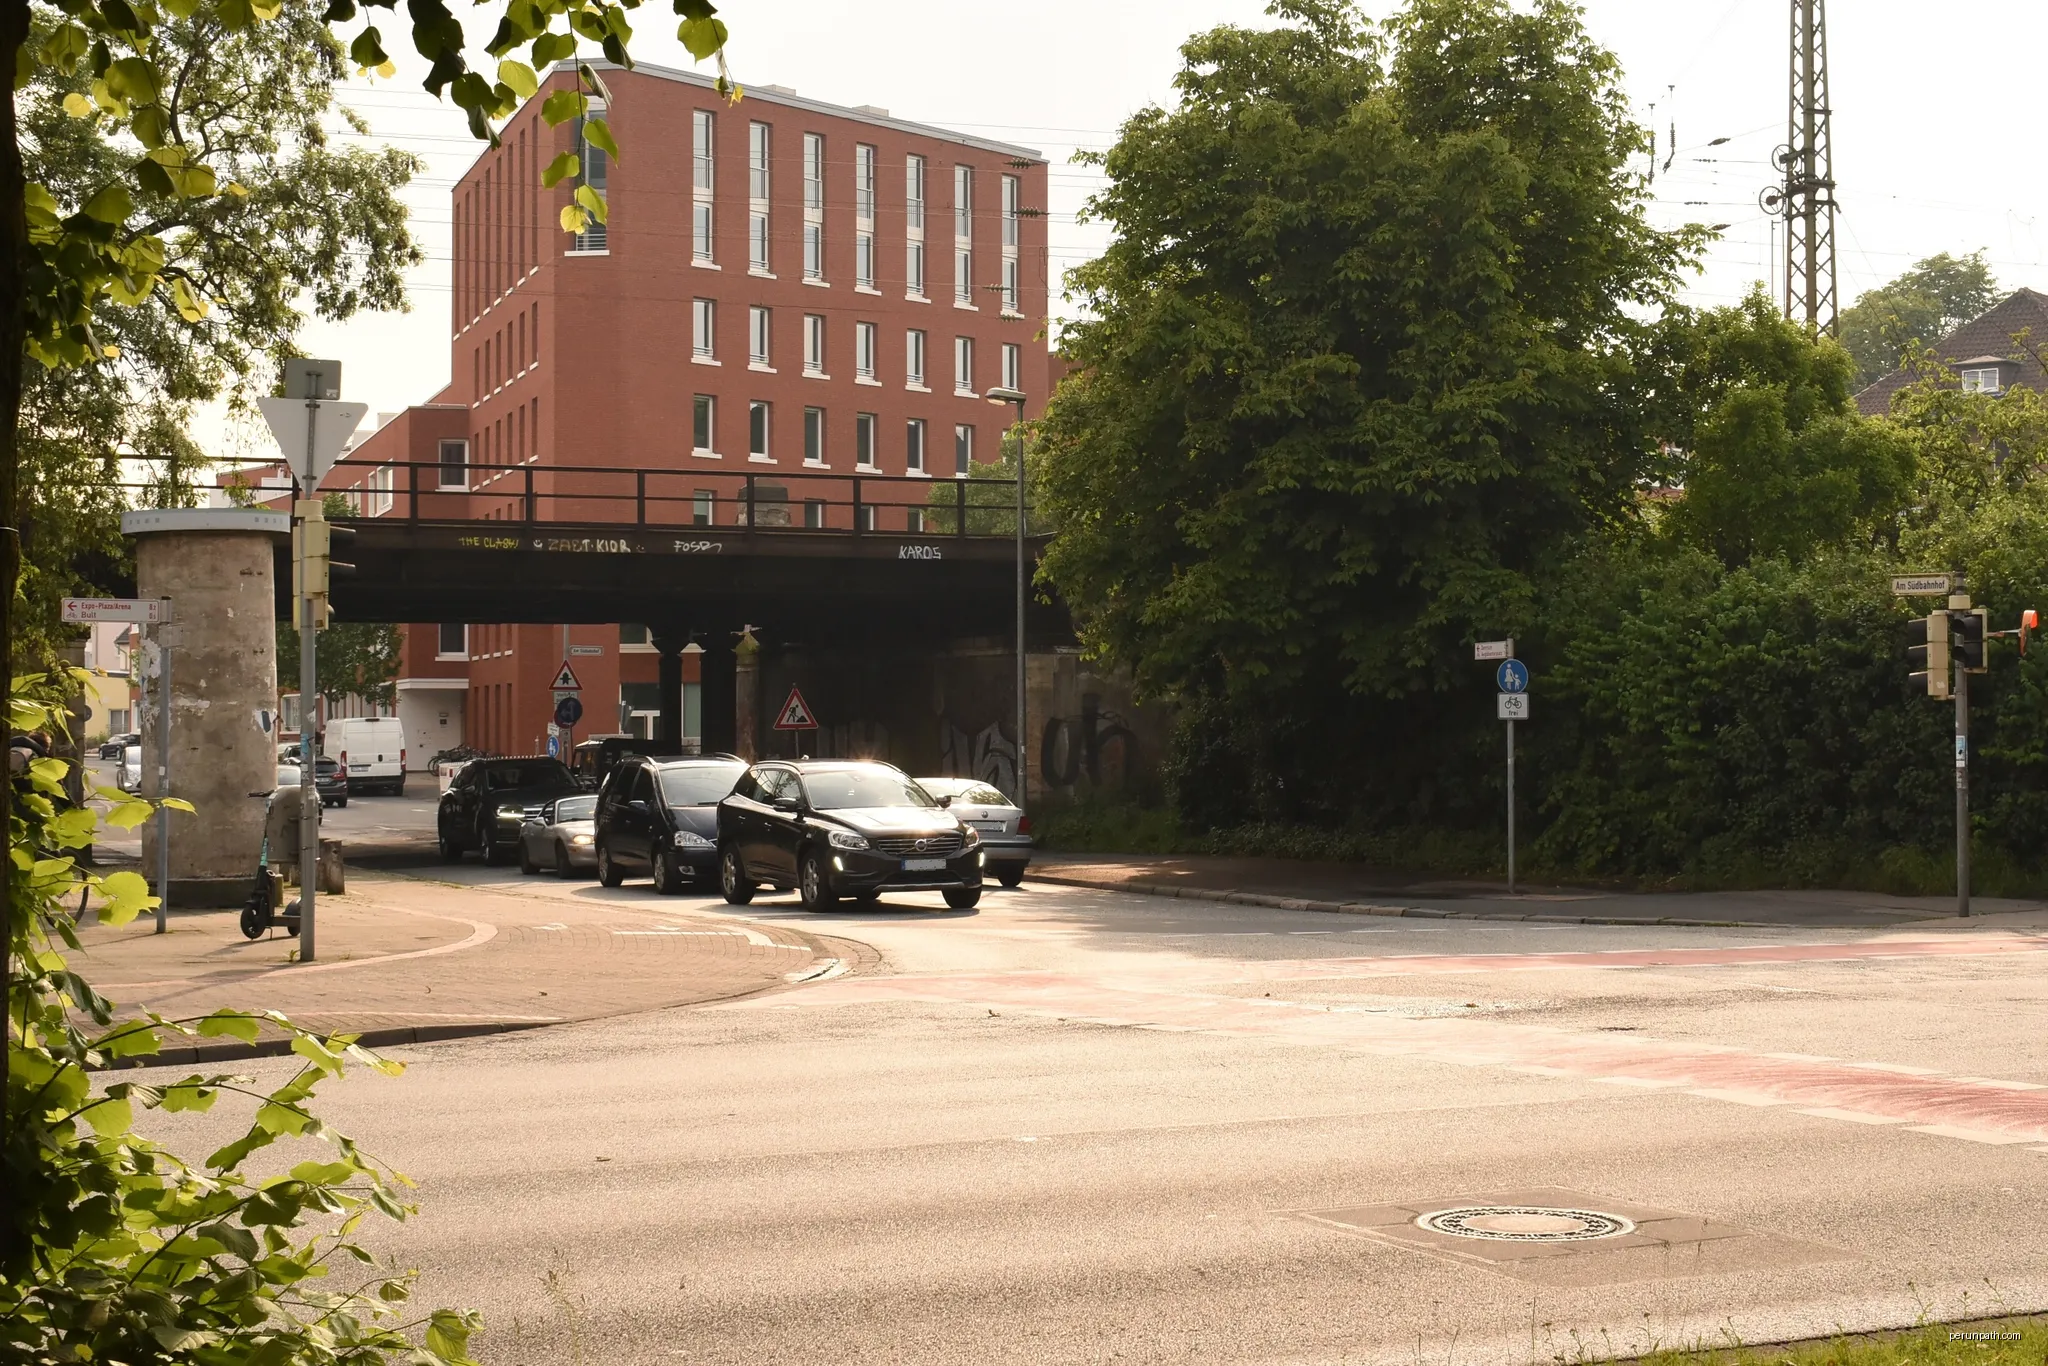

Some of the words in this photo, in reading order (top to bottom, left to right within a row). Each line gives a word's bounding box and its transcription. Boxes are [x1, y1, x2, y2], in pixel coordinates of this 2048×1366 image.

[459, 536, 480, 546] THE
[1896, 581, 1906, 590] Am
[1907, 580, 1945, 590] Südbahnhof
[81, 611, 97, 619] Bult
